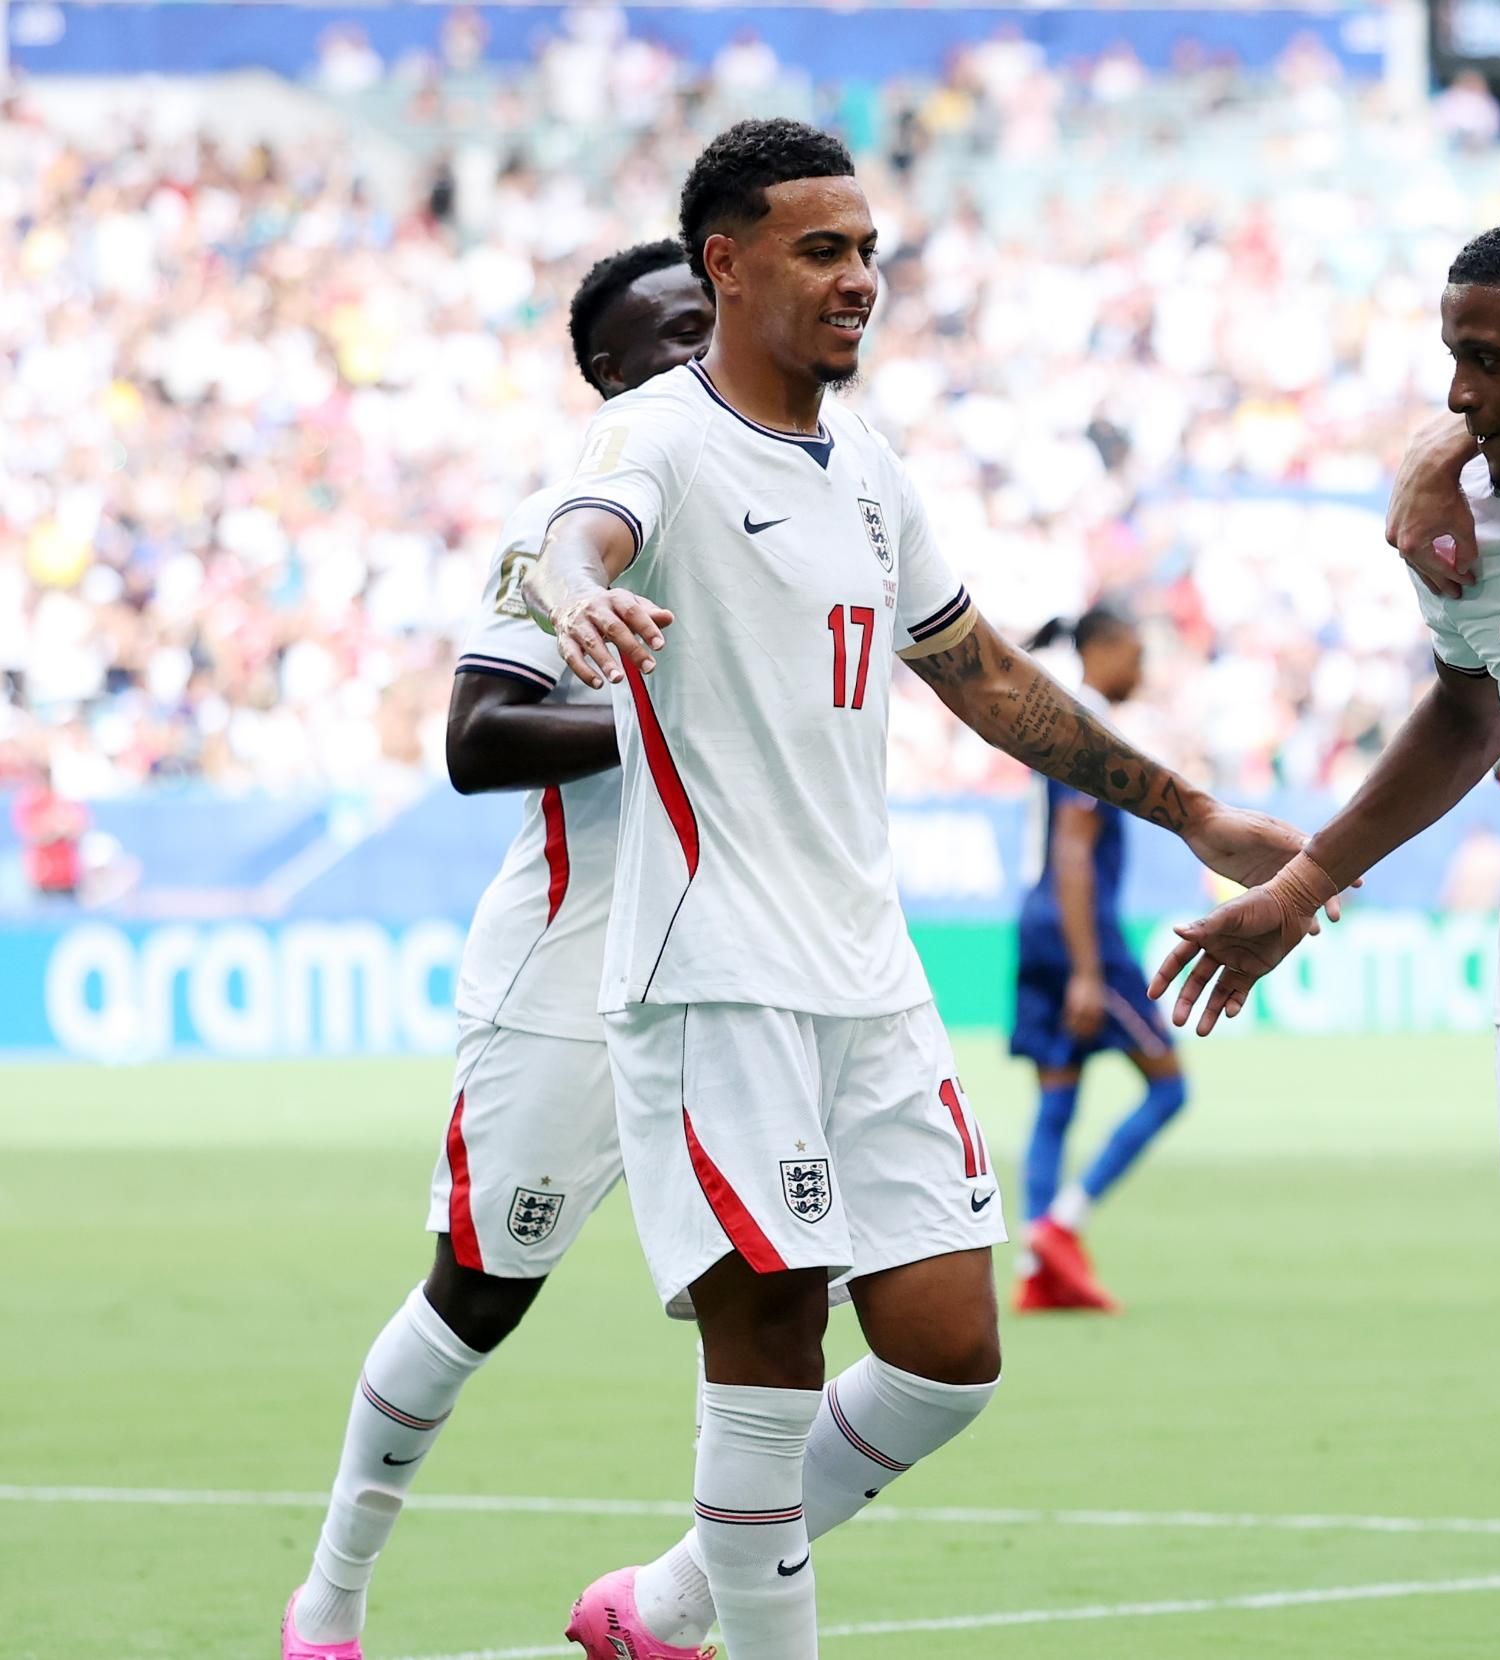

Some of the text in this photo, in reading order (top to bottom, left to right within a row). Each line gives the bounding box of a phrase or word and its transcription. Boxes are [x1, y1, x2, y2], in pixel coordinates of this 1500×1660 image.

[827, 603, 875, 710] 17
[1150, 776, 1188, 831] 27
[44, 920, 463, 1066] aramc
